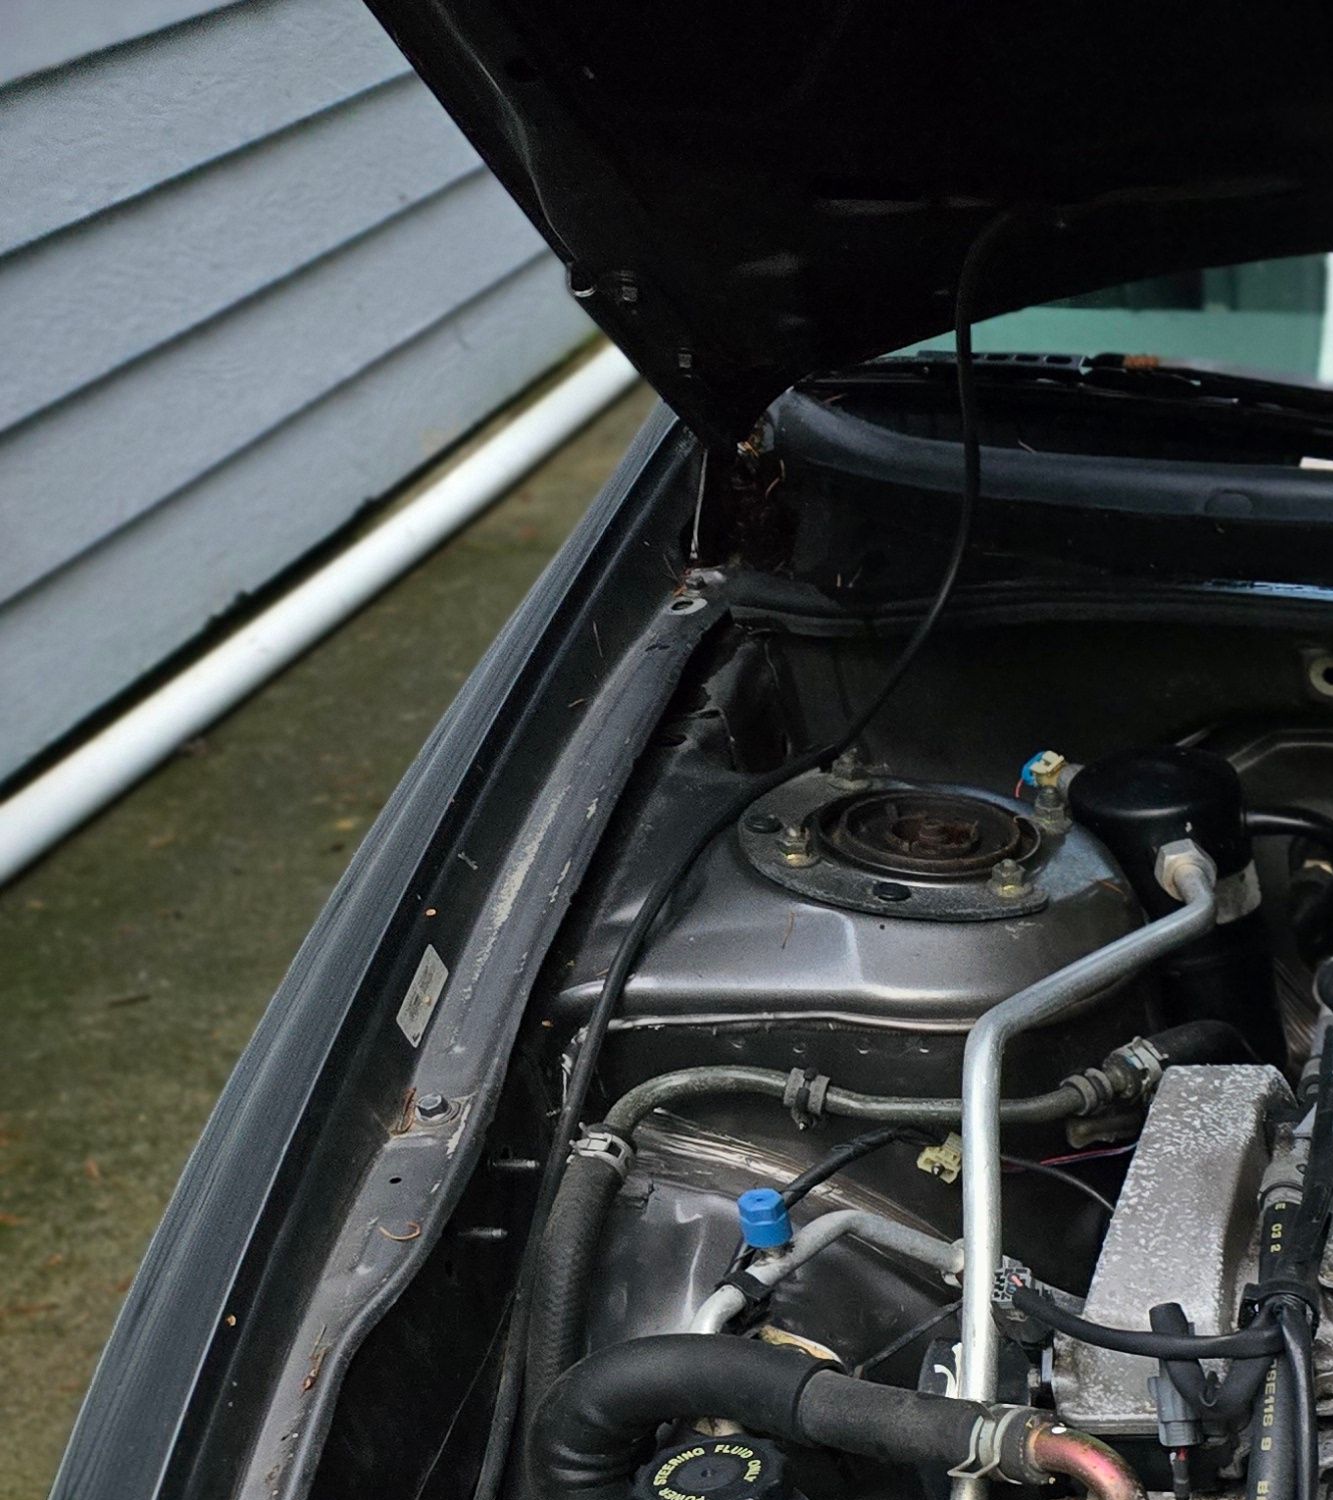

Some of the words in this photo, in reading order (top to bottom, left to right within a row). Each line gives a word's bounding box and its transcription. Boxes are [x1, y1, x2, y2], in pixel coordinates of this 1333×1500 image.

[653, 1447, 705, 1487] STEERING
[714, 1444, 754, 1459] FLUID
[743, 1459, 762, 1483] ONLY
